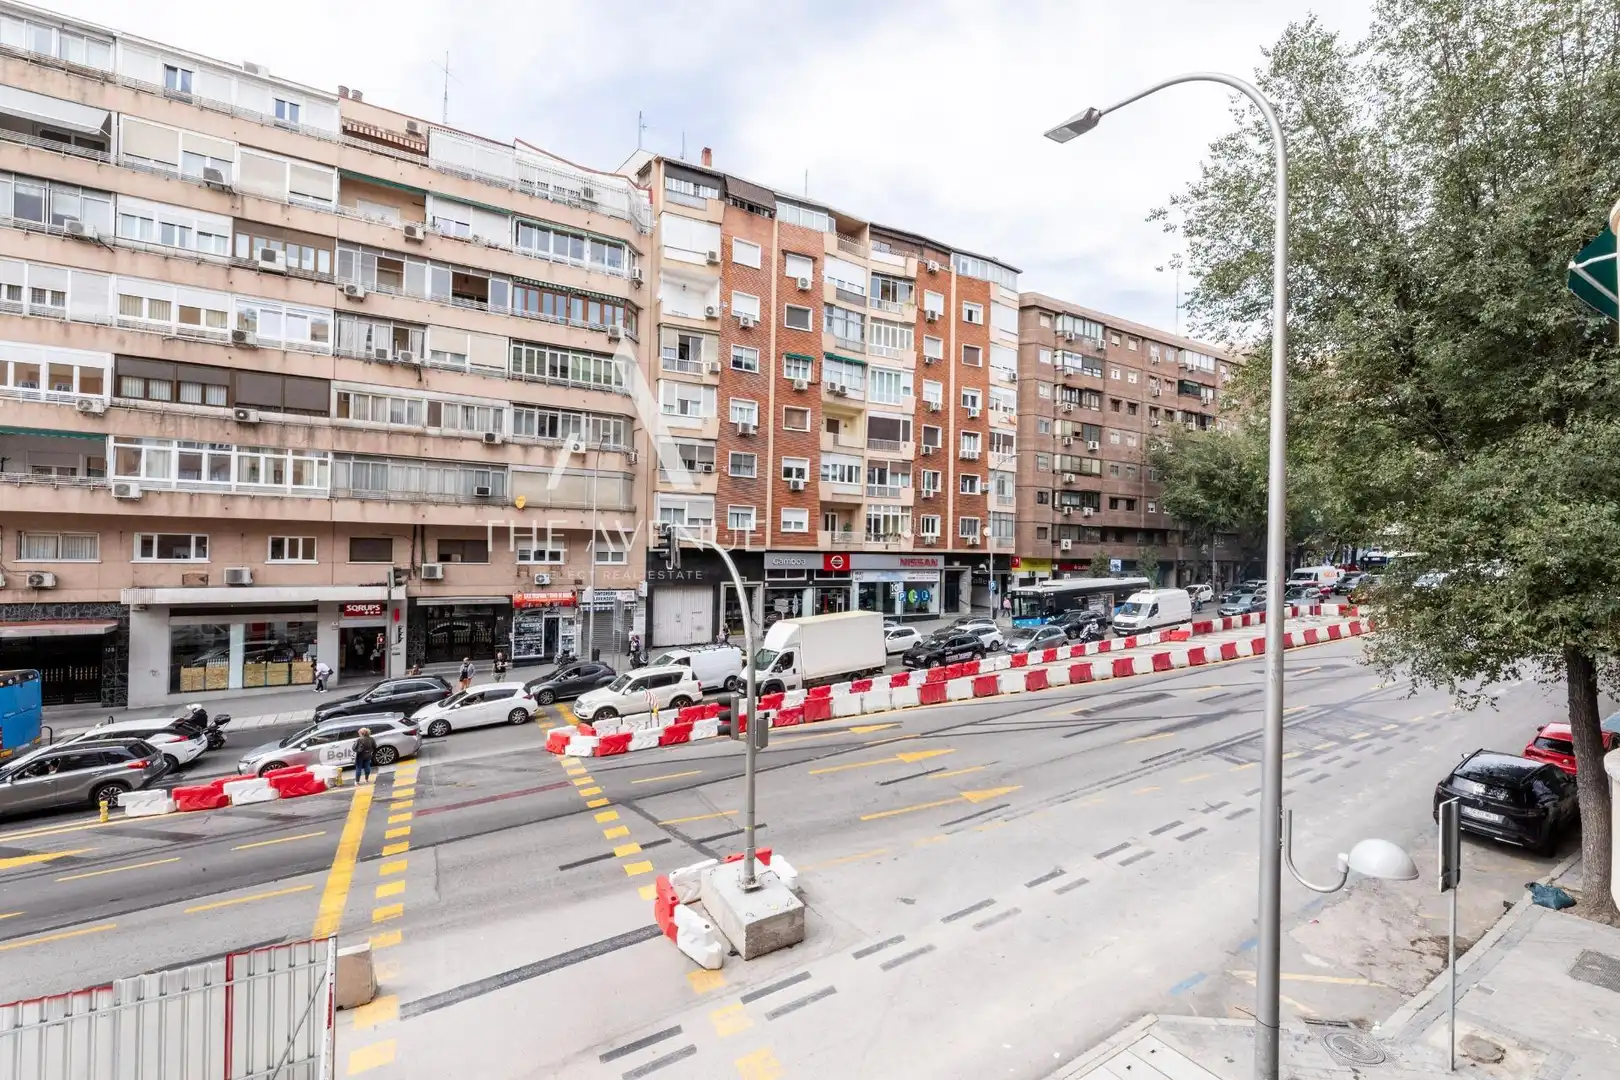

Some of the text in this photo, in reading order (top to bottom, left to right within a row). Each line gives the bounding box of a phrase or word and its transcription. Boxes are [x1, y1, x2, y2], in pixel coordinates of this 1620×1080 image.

[772, 556, 806, 566] Gamboa
[899, 558, 939, 568] NISSAN
[326, 747, 353, 761] Bolt
